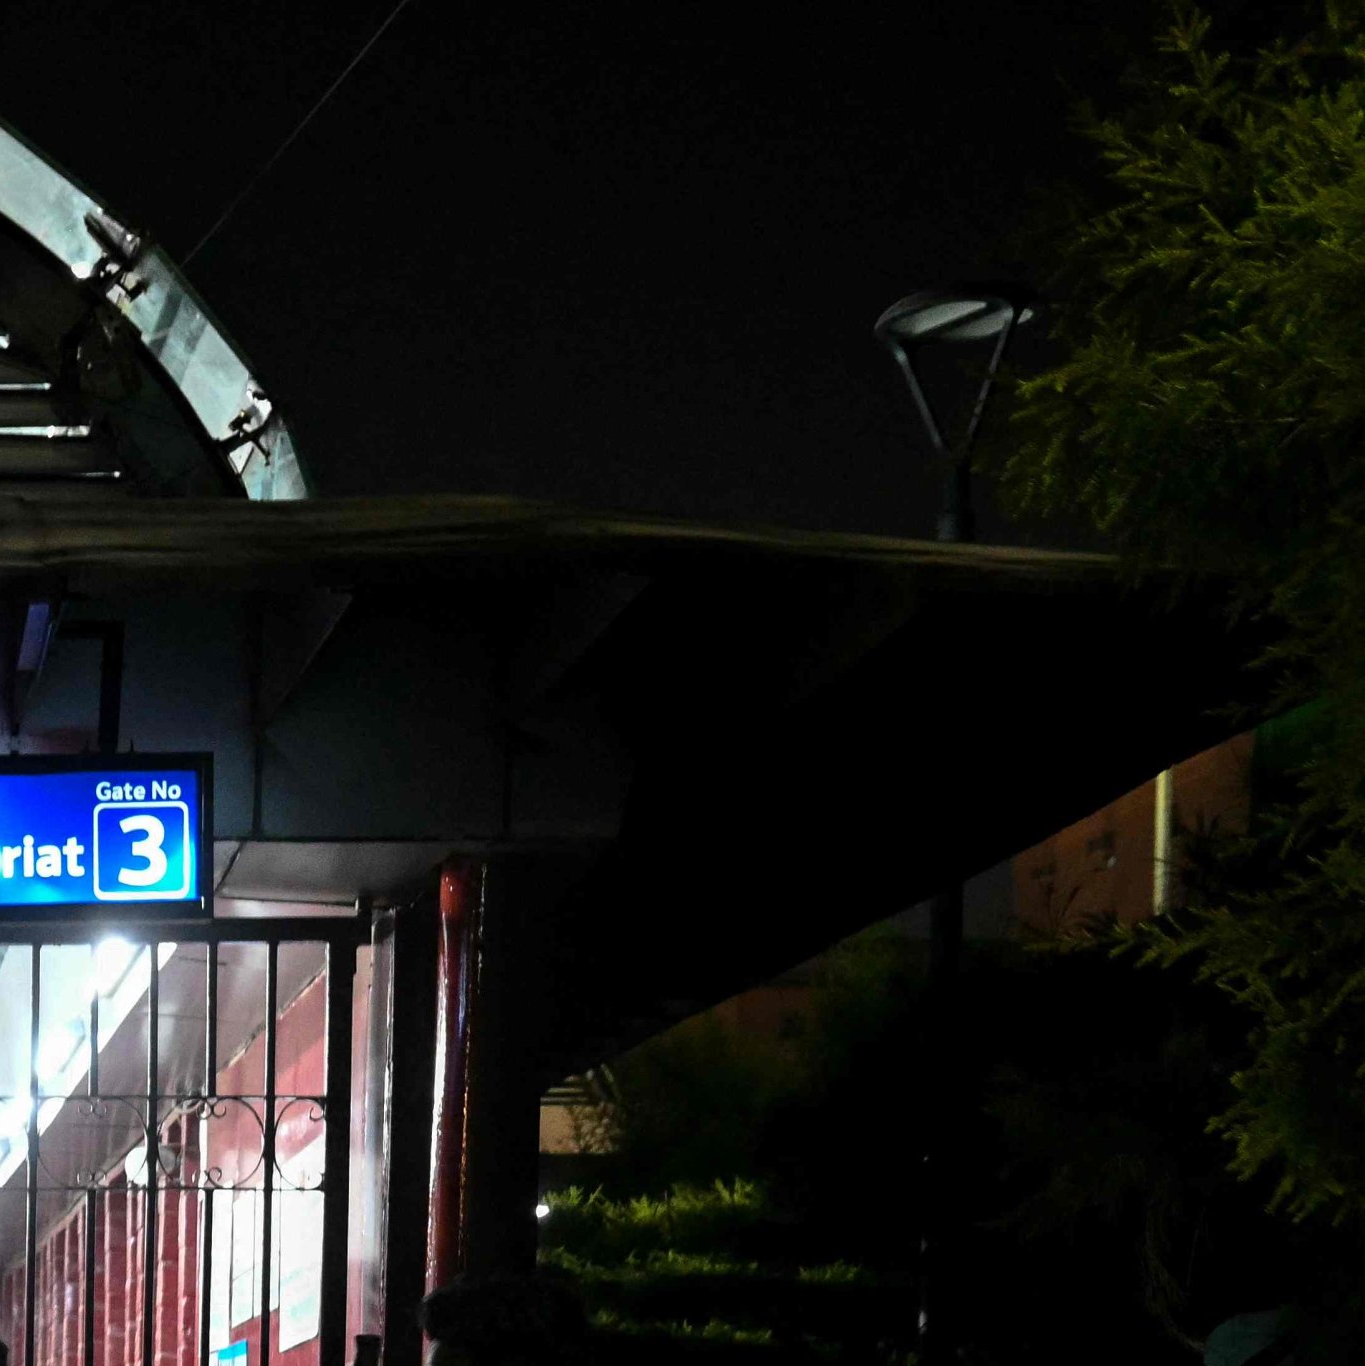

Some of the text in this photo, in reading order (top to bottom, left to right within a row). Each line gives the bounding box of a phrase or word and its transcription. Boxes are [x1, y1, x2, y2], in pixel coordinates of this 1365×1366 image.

[96, 780, 182, 801] Gate No
[117, 814, 168, 887] 3
